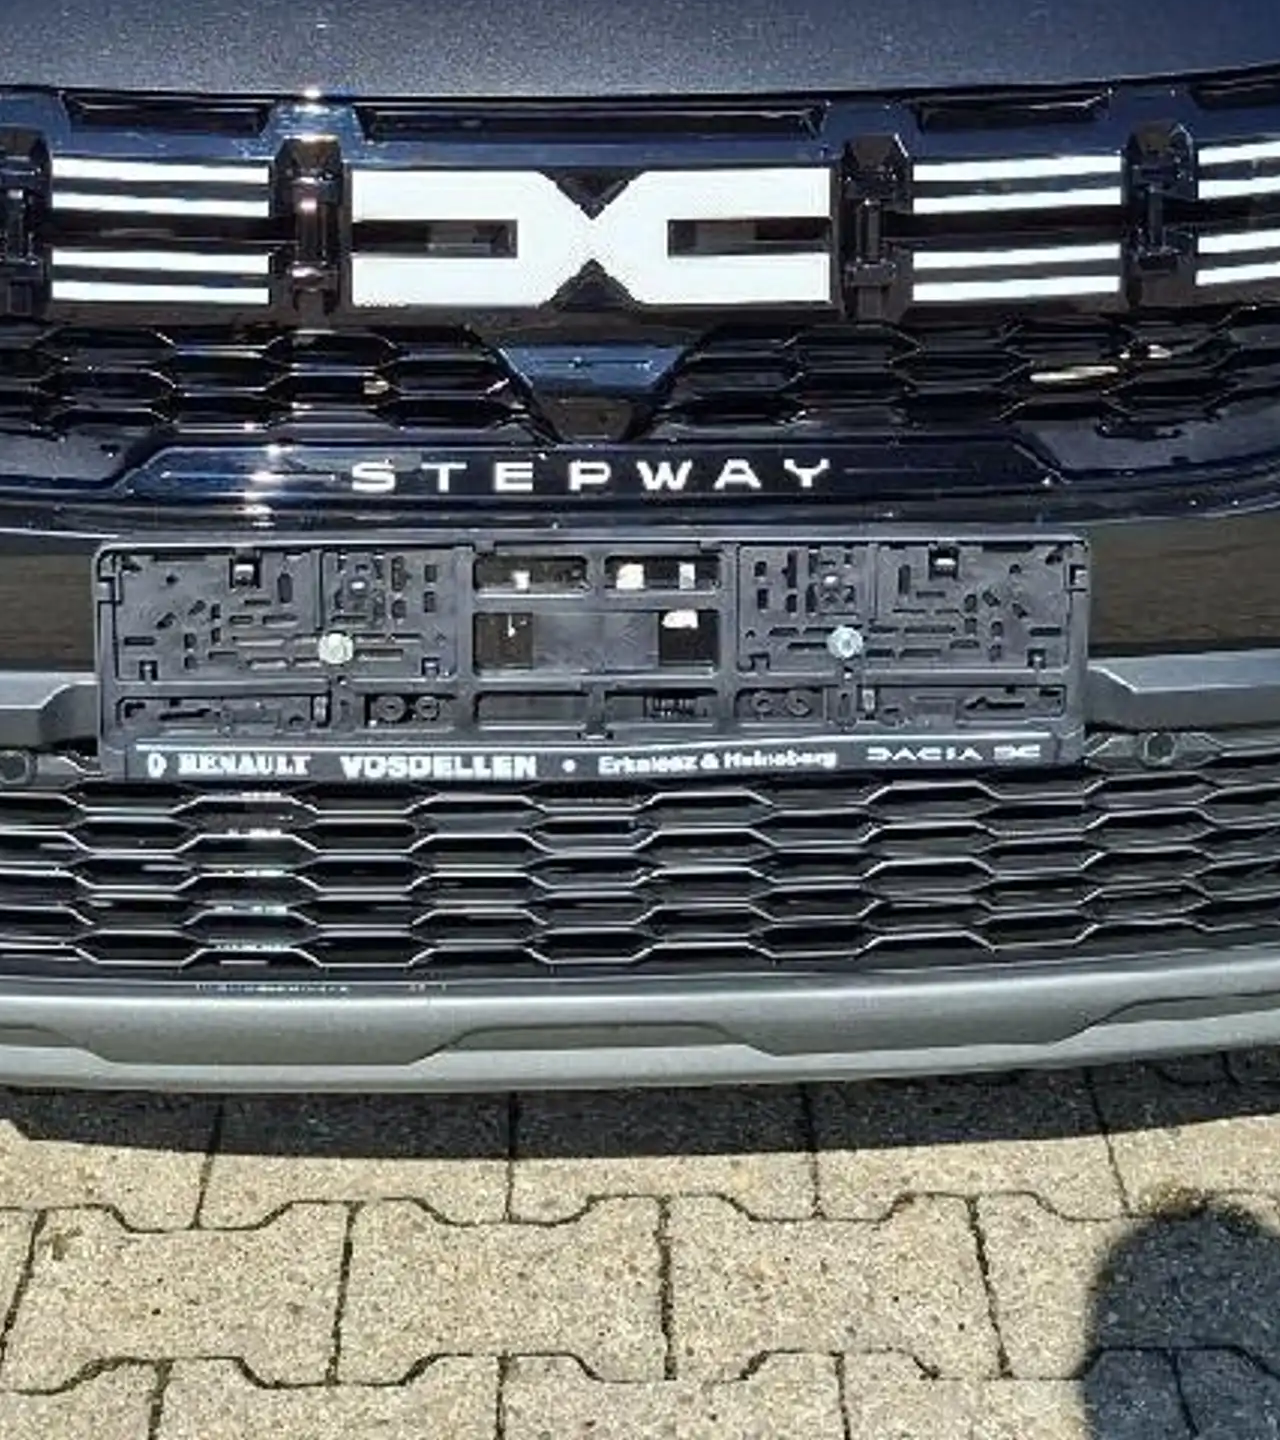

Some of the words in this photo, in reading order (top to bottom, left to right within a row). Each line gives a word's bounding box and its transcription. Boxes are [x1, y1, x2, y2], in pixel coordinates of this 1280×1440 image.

[351, 458, 831, 494] STEPWAY
[177, 752, 312, 776] RENAULT
[339, 755, 537, 780] VOSDELLEN
[867, 746, 983, 761] DACIA
